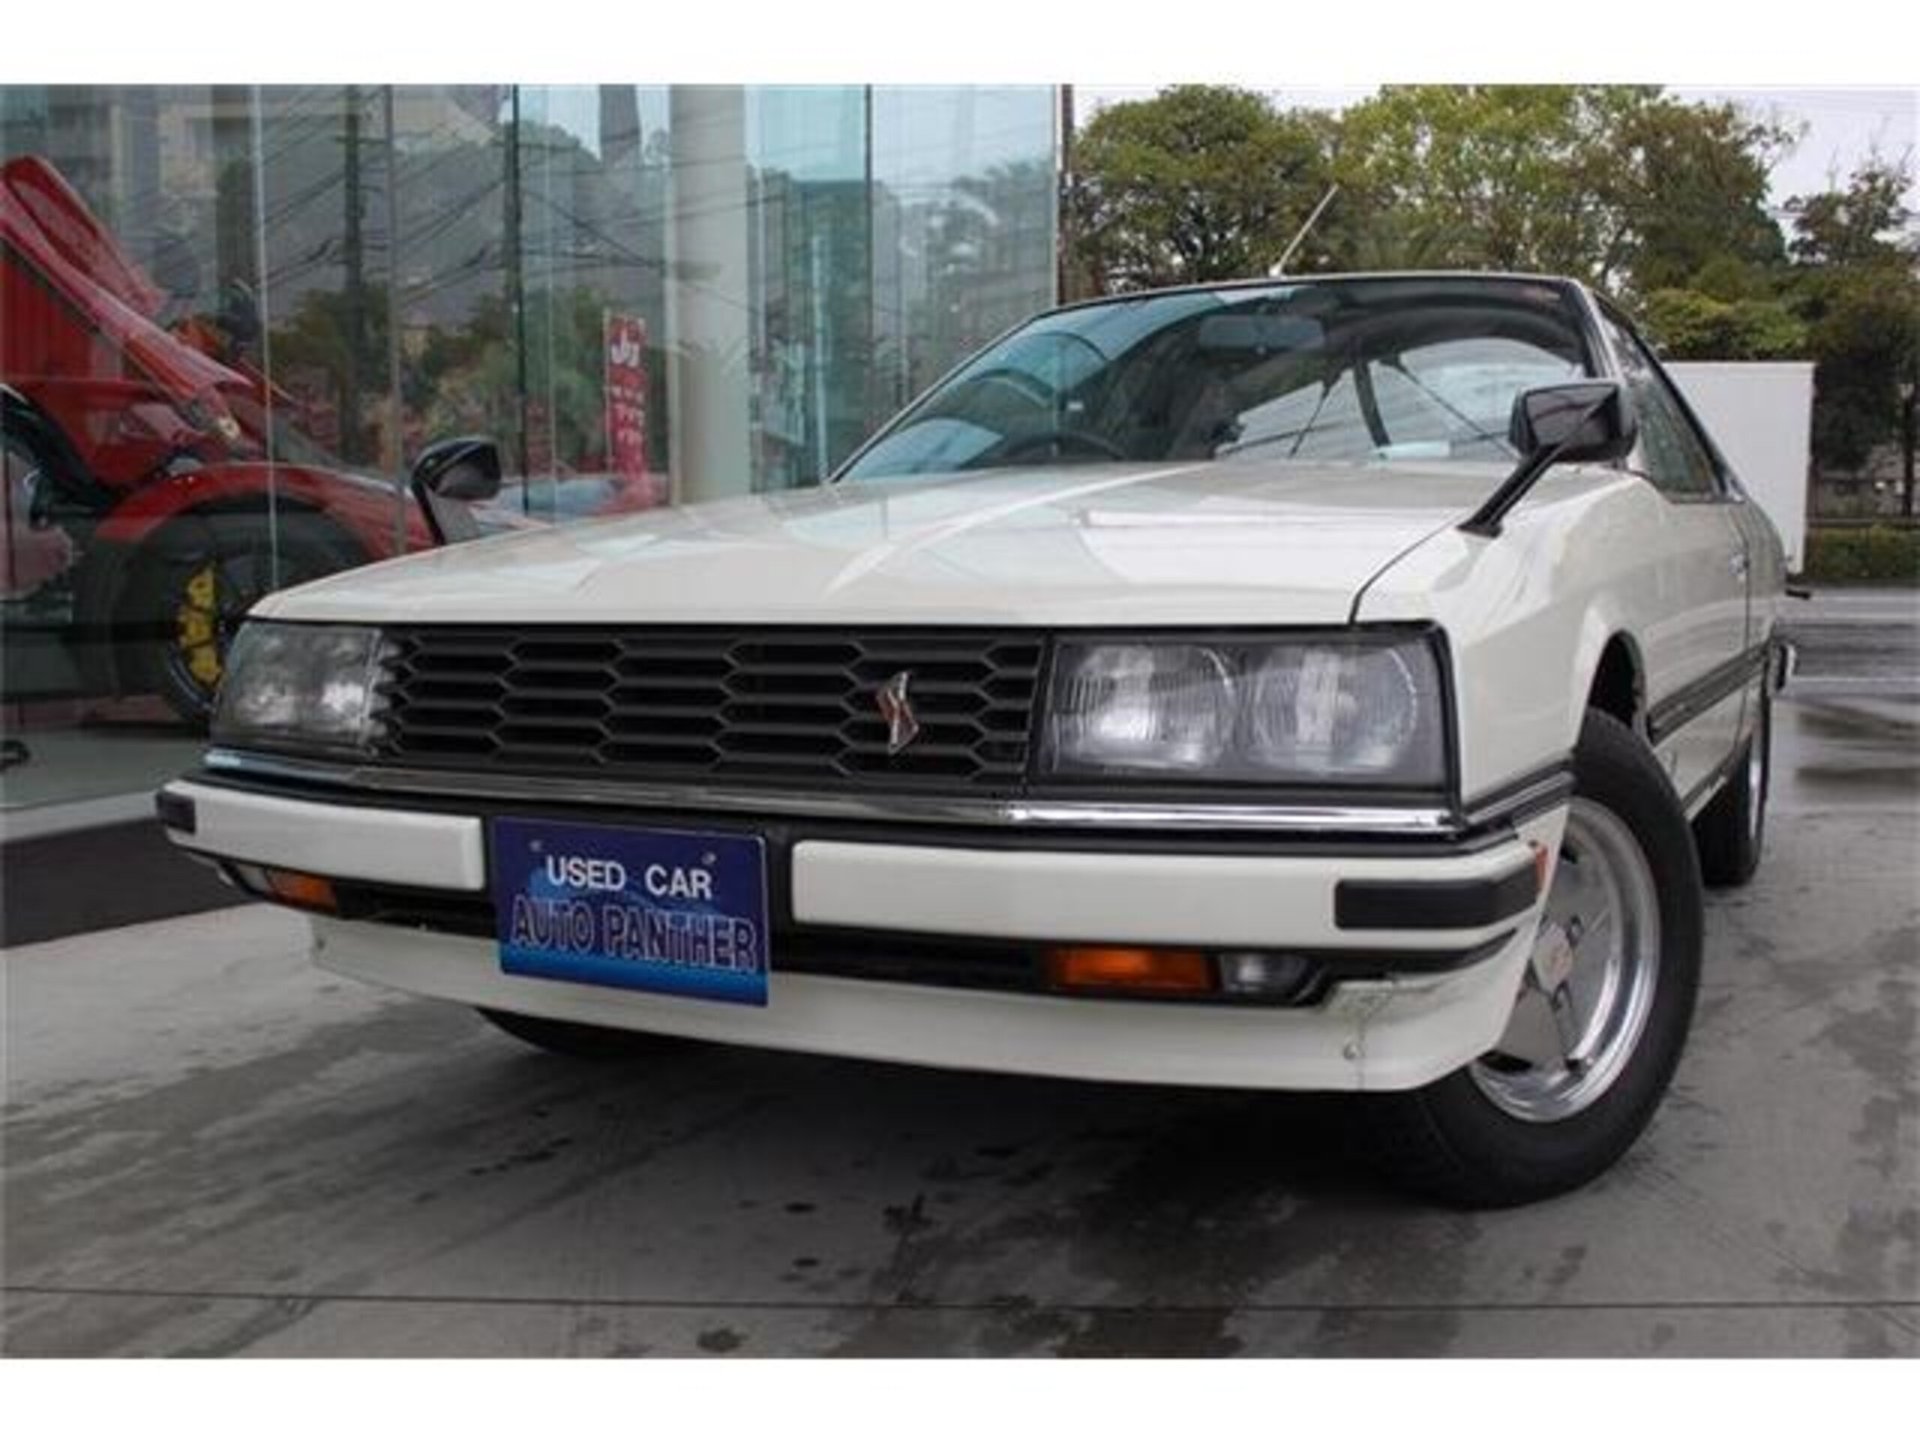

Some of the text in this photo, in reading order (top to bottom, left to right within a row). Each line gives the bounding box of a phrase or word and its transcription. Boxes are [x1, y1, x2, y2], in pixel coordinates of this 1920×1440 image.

[547, 855, 712, 900] USED CAR
[511, 895, 757, 972] AUTO PANTHER
